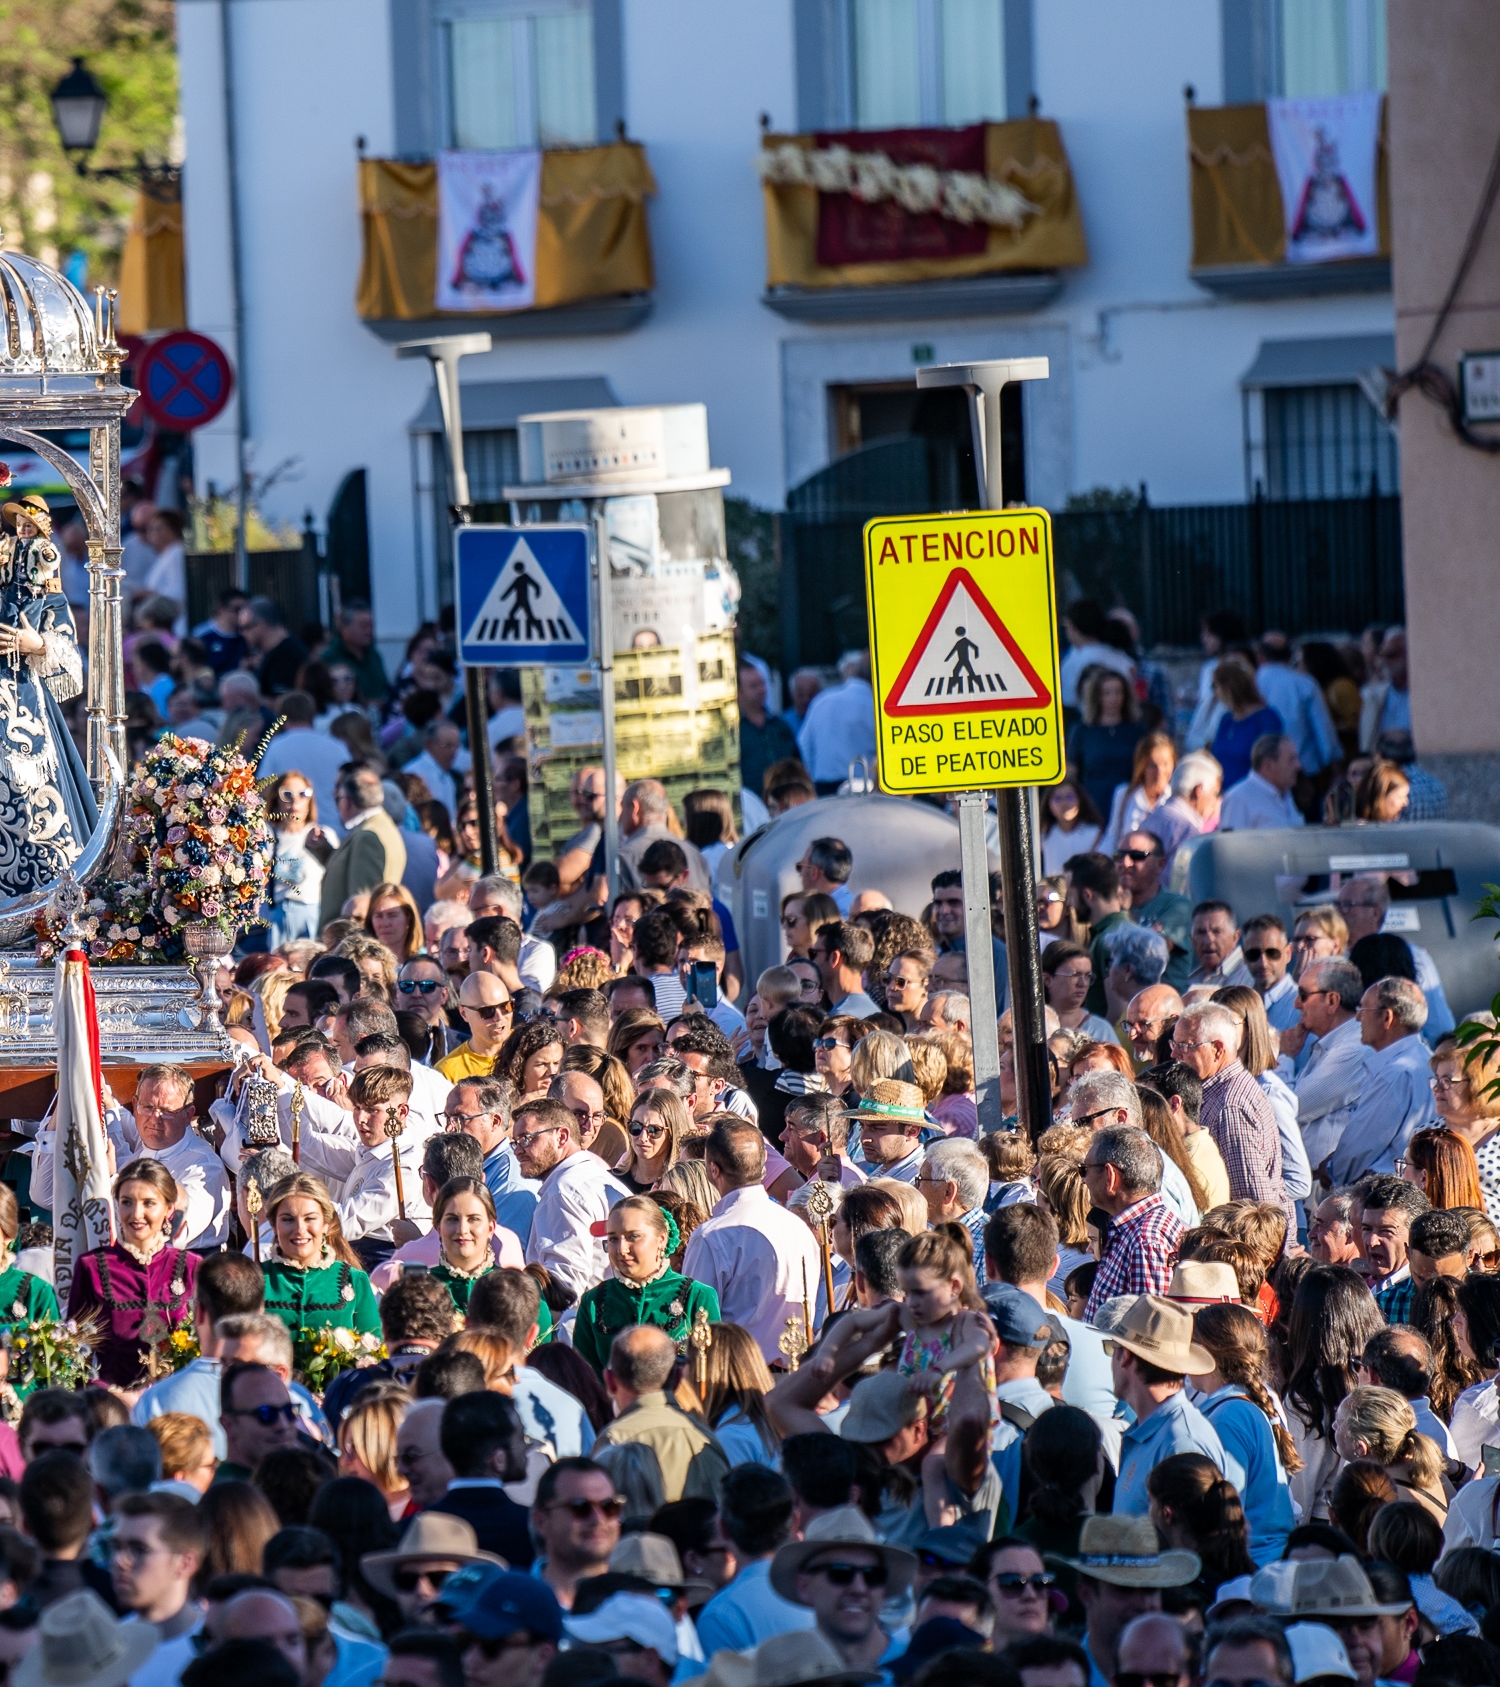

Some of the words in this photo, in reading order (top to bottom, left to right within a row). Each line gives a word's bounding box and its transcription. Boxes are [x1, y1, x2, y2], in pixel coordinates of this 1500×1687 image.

[878, 527, 1040, 566] ATENCION
[890, 723, 944, 745] PASO
[954, 716, 1048, 741] ELEVADO
[901, 756, 927, 776] DE
[937, 747, 1043, 774] PEATONES
